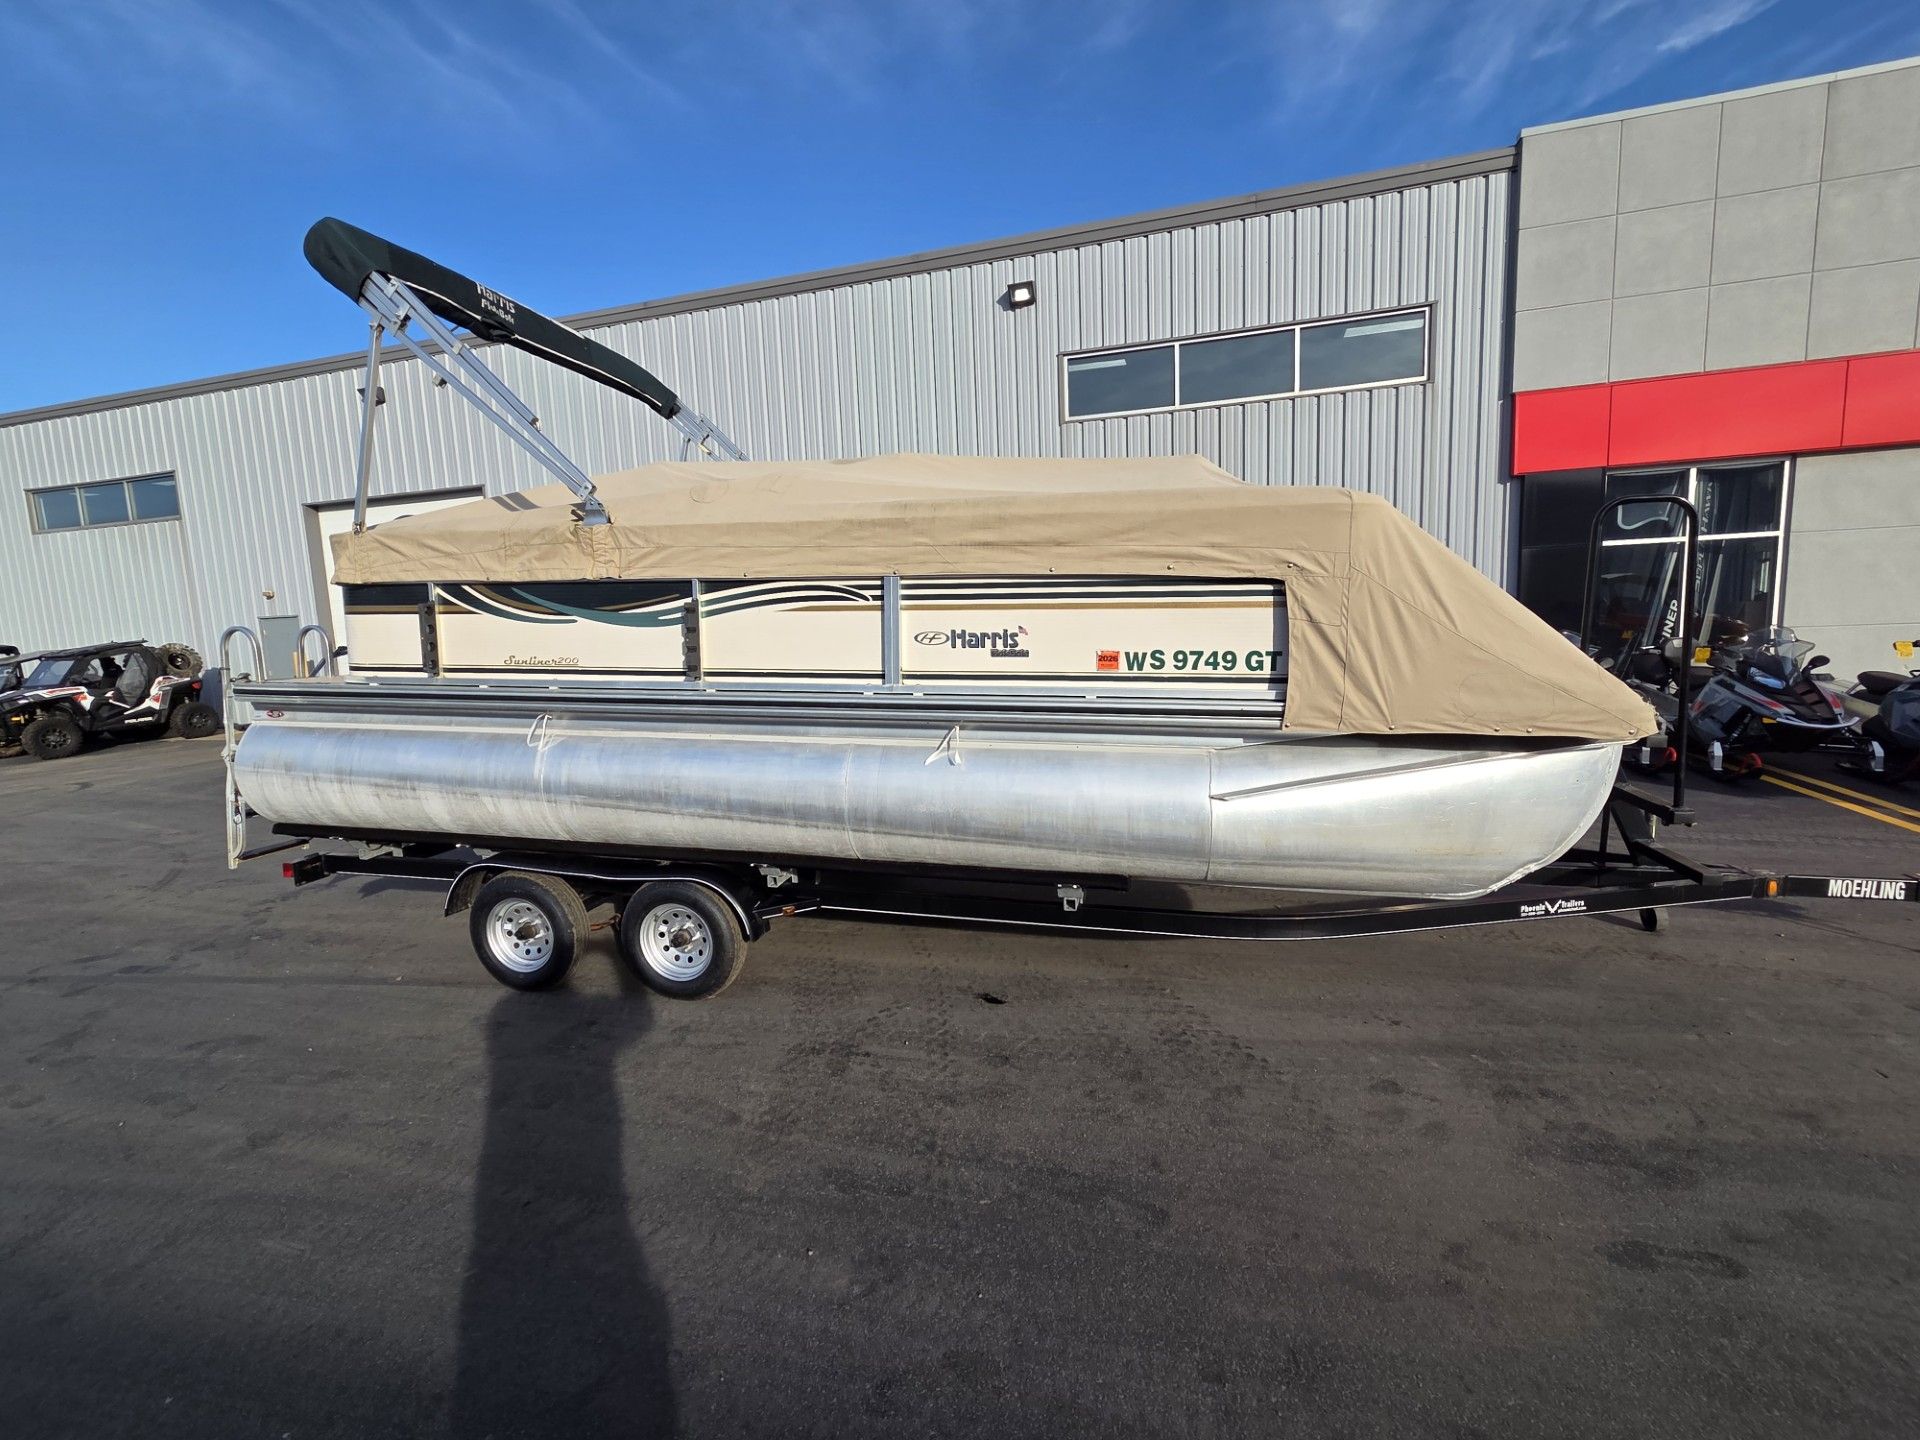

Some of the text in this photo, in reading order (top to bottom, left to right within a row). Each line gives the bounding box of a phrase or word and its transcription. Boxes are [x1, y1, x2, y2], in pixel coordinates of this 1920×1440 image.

[477, 283, 516, 314] Harris
[950, 629, 1019, 649] Harris
[1098, 655, 1119, 663] 2026
[1124, 649, 1283, 672] WS 9749 GT
[1827, 879, 1906, 900] MOEHLING
